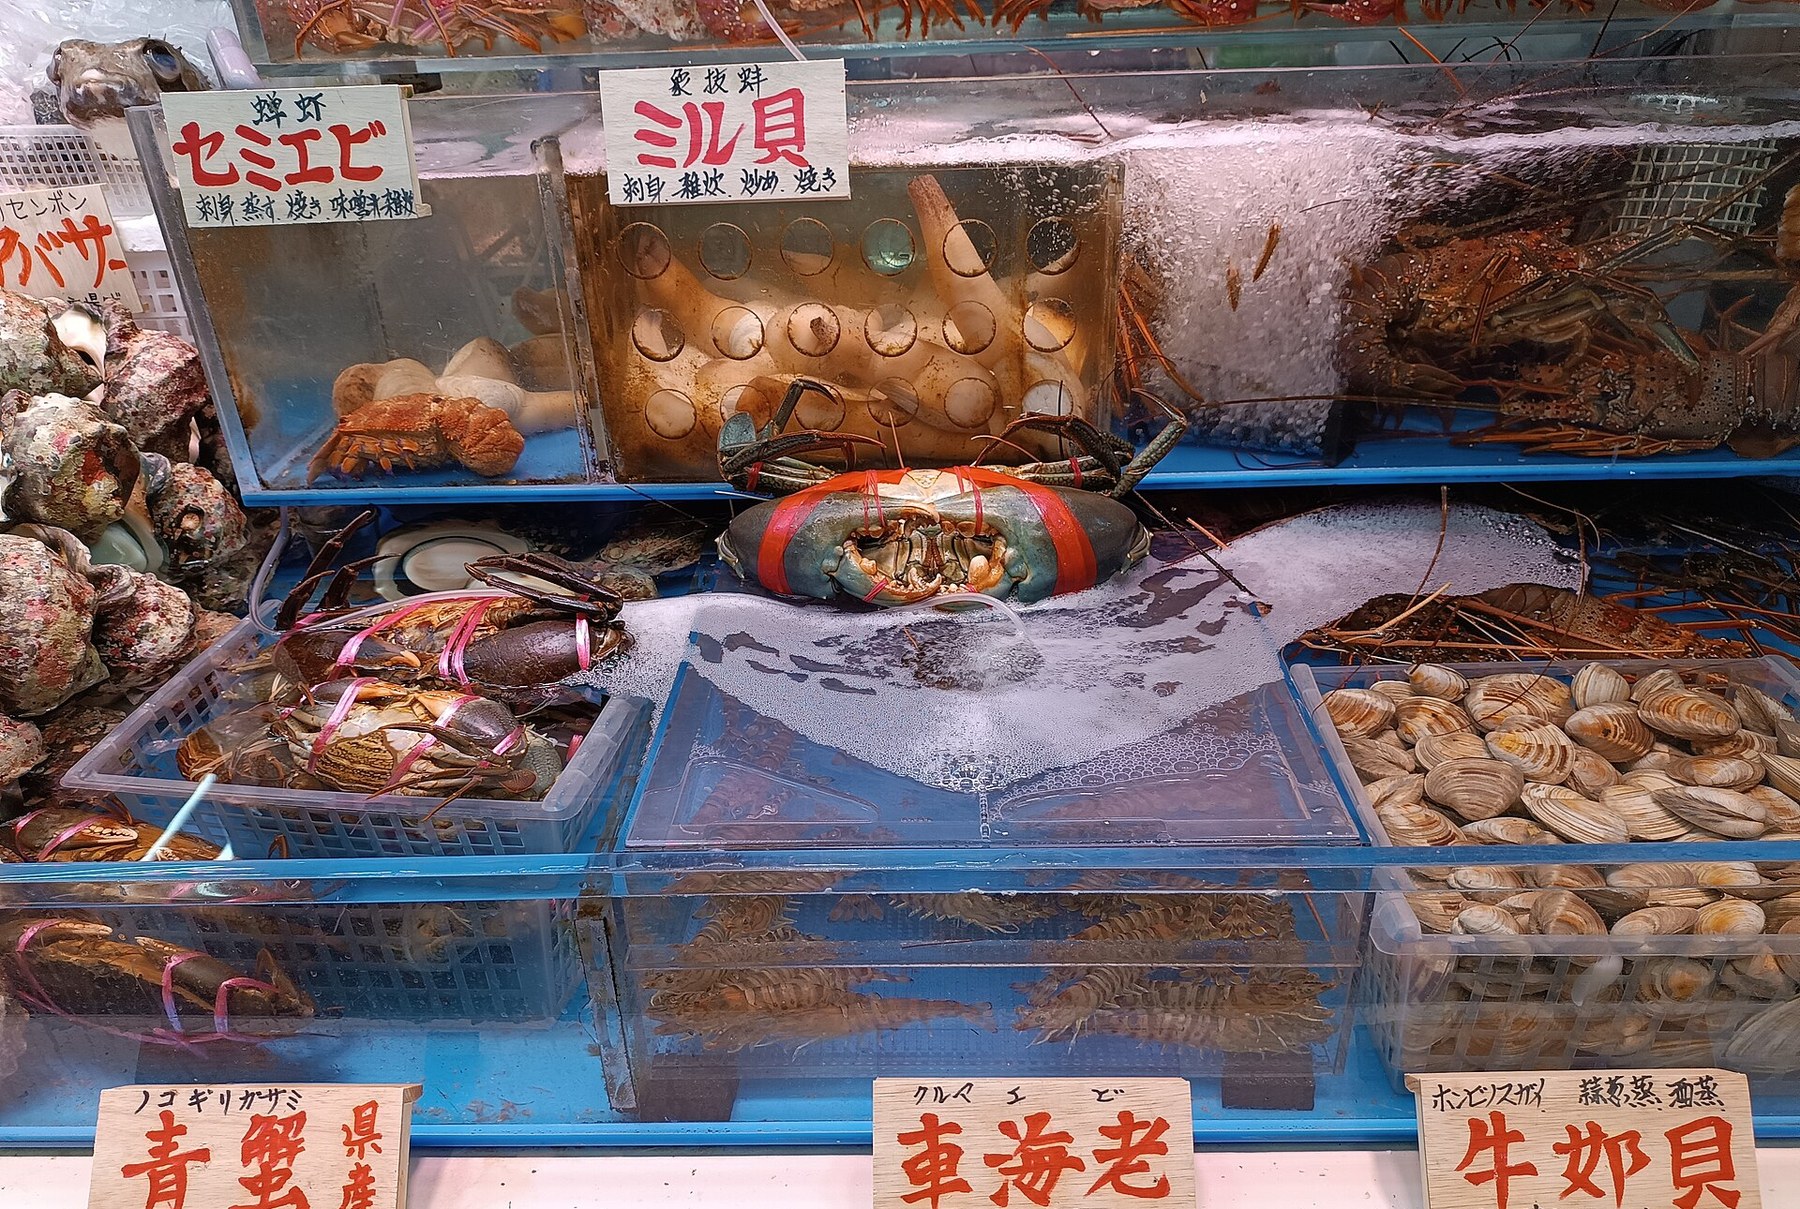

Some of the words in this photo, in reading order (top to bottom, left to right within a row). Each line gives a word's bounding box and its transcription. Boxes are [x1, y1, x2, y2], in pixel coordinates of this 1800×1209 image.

[172, 120, 387, 192] セミエビ
[634, 87, 810, 168] ミル貝
[134, 1088, 303, 1116] ノコギリガサミ
[121, 1109, 312, 1209] 青蟹
[897, 1110, 1171, 1209] 車海老
[1454, 1110, 1742, 1209] 牛奶貝
